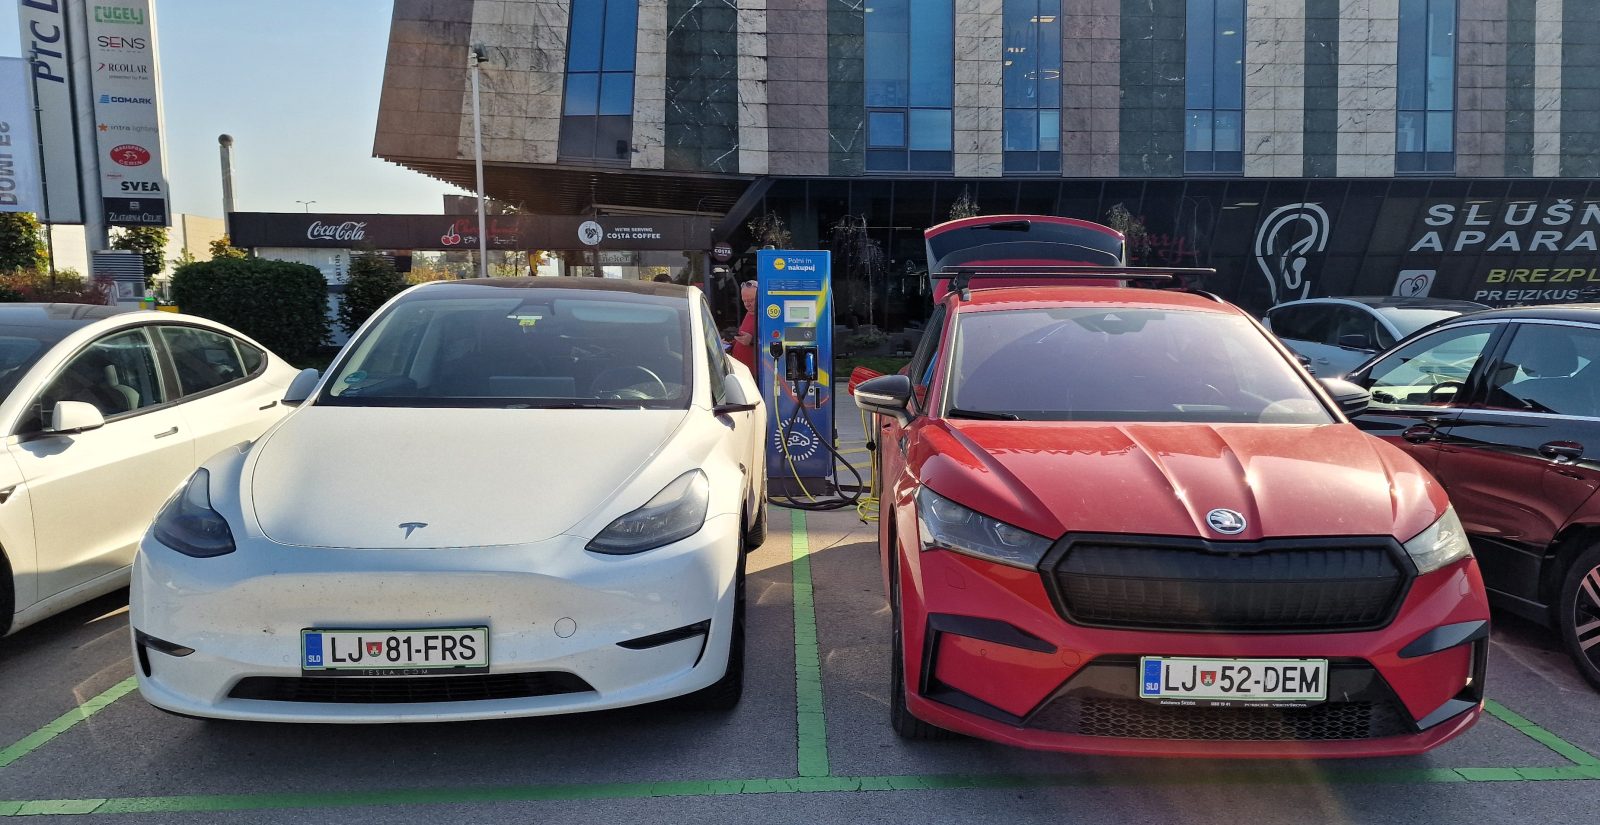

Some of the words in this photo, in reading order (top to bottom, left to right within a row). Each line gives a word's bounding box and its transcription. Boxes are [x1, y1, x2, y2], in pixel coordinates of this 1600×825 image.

[97, 35, 146, 50] SENS
[30, 19, 65, 83] PTC
[108, 62, 148, 73] RCOLLAR
[111, 96, 152, 105] COMARK
[121, 181, 161, 192] SVEA
[307, 220, 368, 241] Coca-Cola
[607, 232, 631, 240] COSTA
[787, 264, 816, 272] nakupuj
[330, 636, 363, 663] LJ
[385, 634, 477, 663] 81-FRS
[308, 655, 321, 663] SLO
[1164, 664, 1197, 692] LJ
[1219, 665, 1321, 693] 52-DEM
[1146, 682, 1159, 691] SLO
